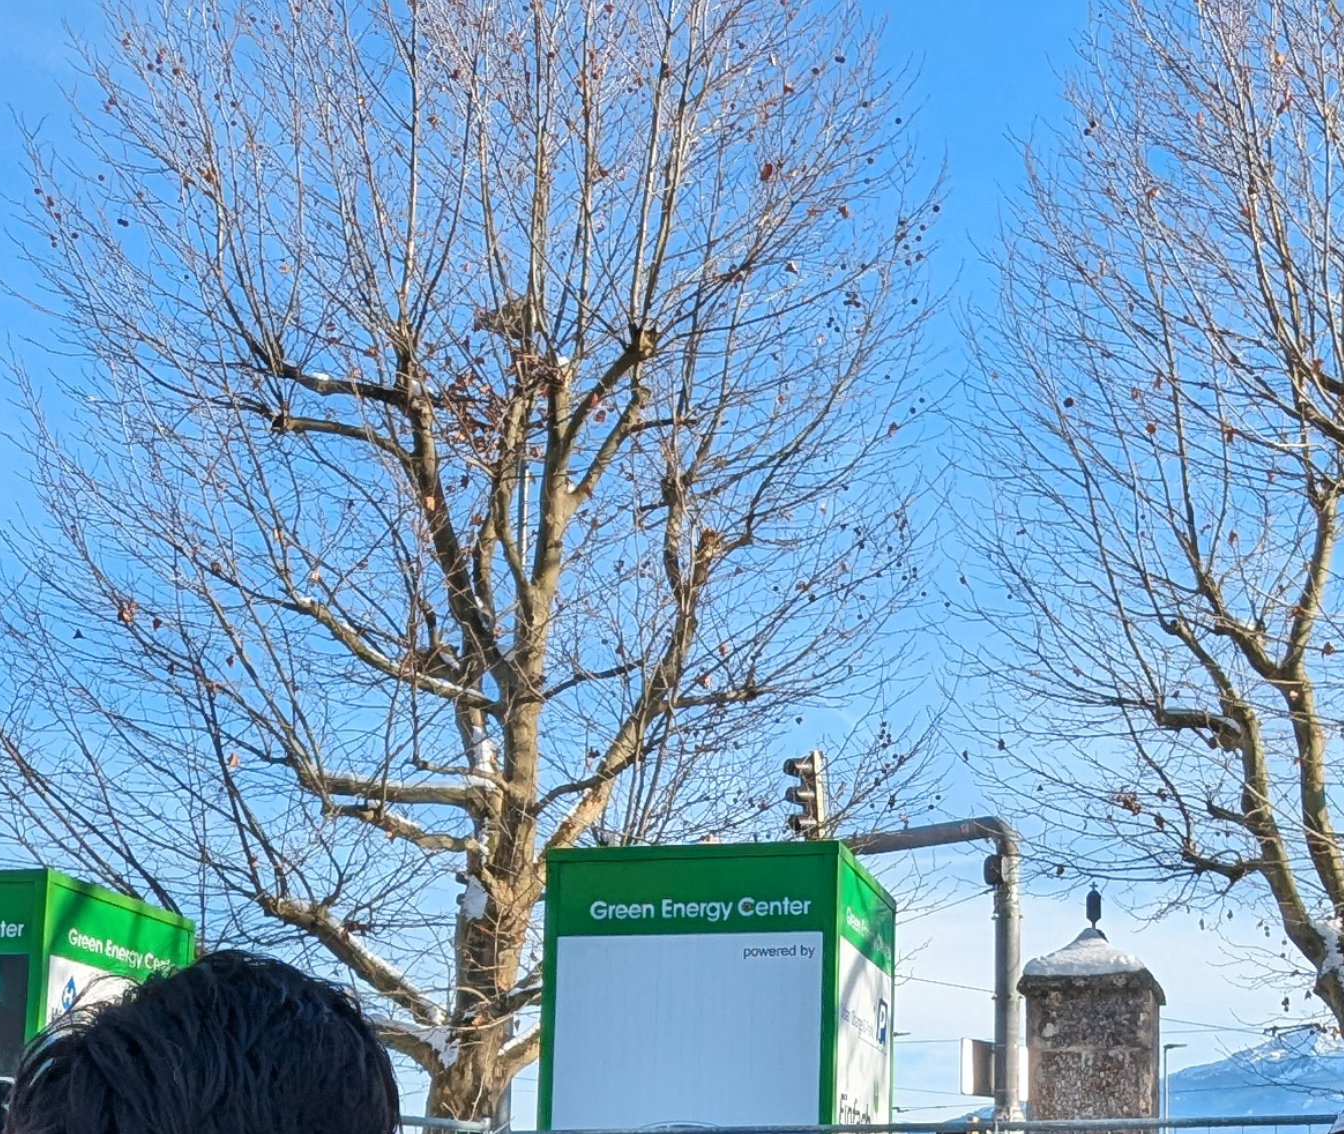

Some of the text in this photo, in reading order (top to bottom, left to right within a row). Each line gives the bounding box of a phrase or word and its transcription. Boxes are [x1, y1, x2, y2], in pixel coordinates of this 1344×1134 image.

[589, 896, 811, 922] Green Energy Center
[68, 928, 103, 953] Green
[105, 939, 143, 969] Energy
[743, 943, 816, 959] powered by
